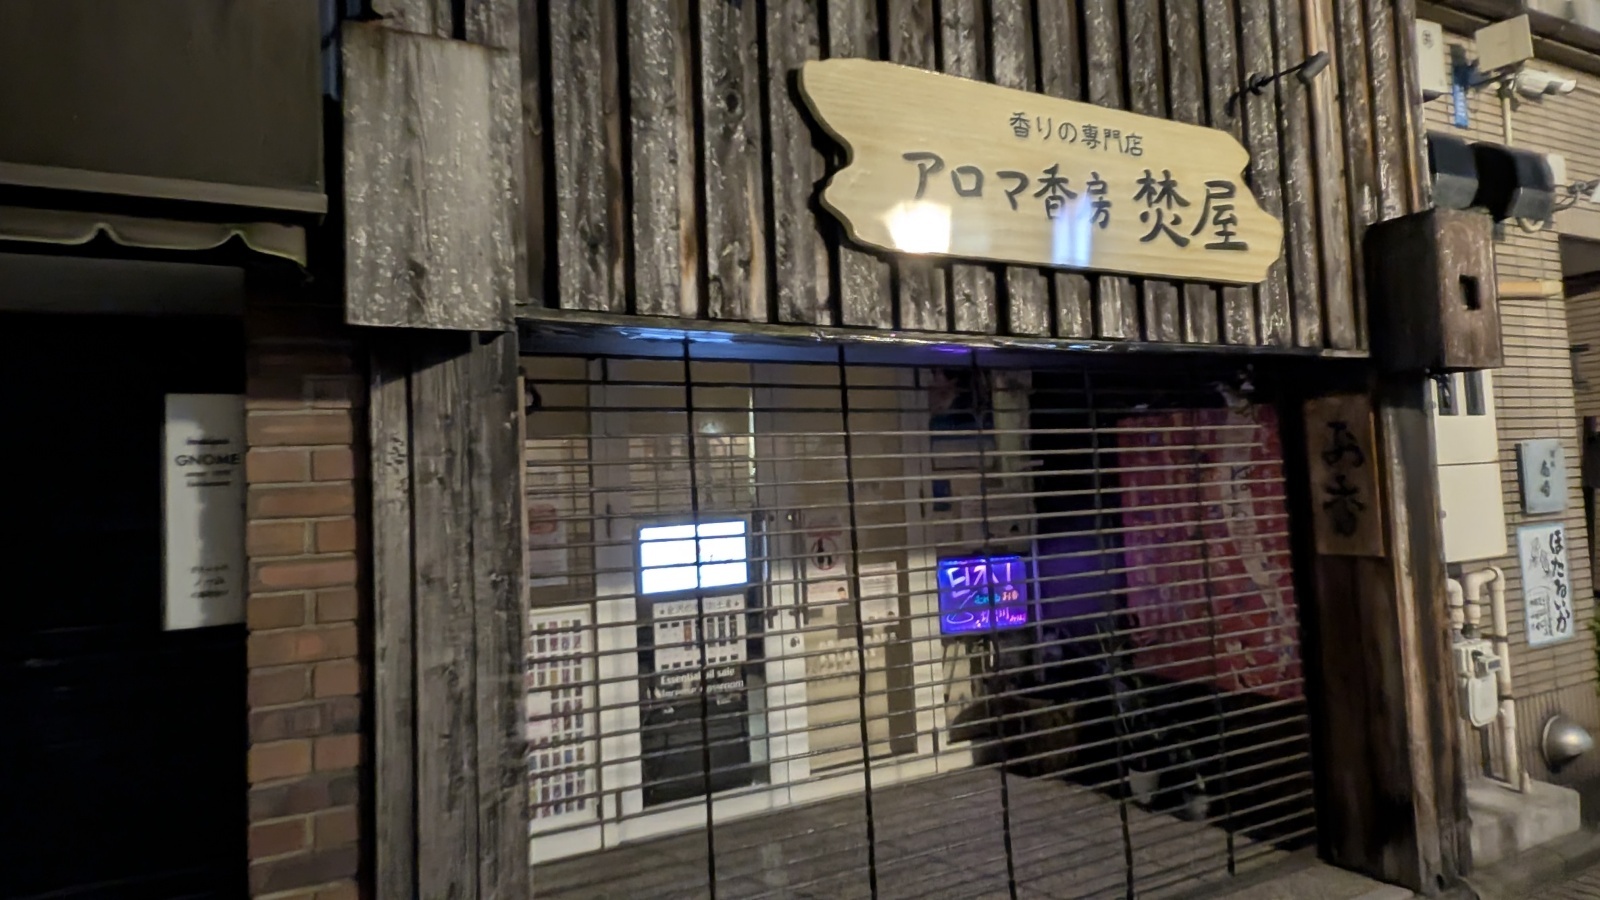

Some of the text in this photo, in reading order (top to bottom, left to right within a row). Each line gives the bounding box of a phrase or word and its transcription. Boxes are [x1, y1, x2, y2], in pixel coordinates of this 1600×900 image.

[1009, 110, 1144, 157] 香りの専門店
[902, 150, 1250, 251] アロマ香房 焚屋
[174, 453, 241, 467] GNOME
